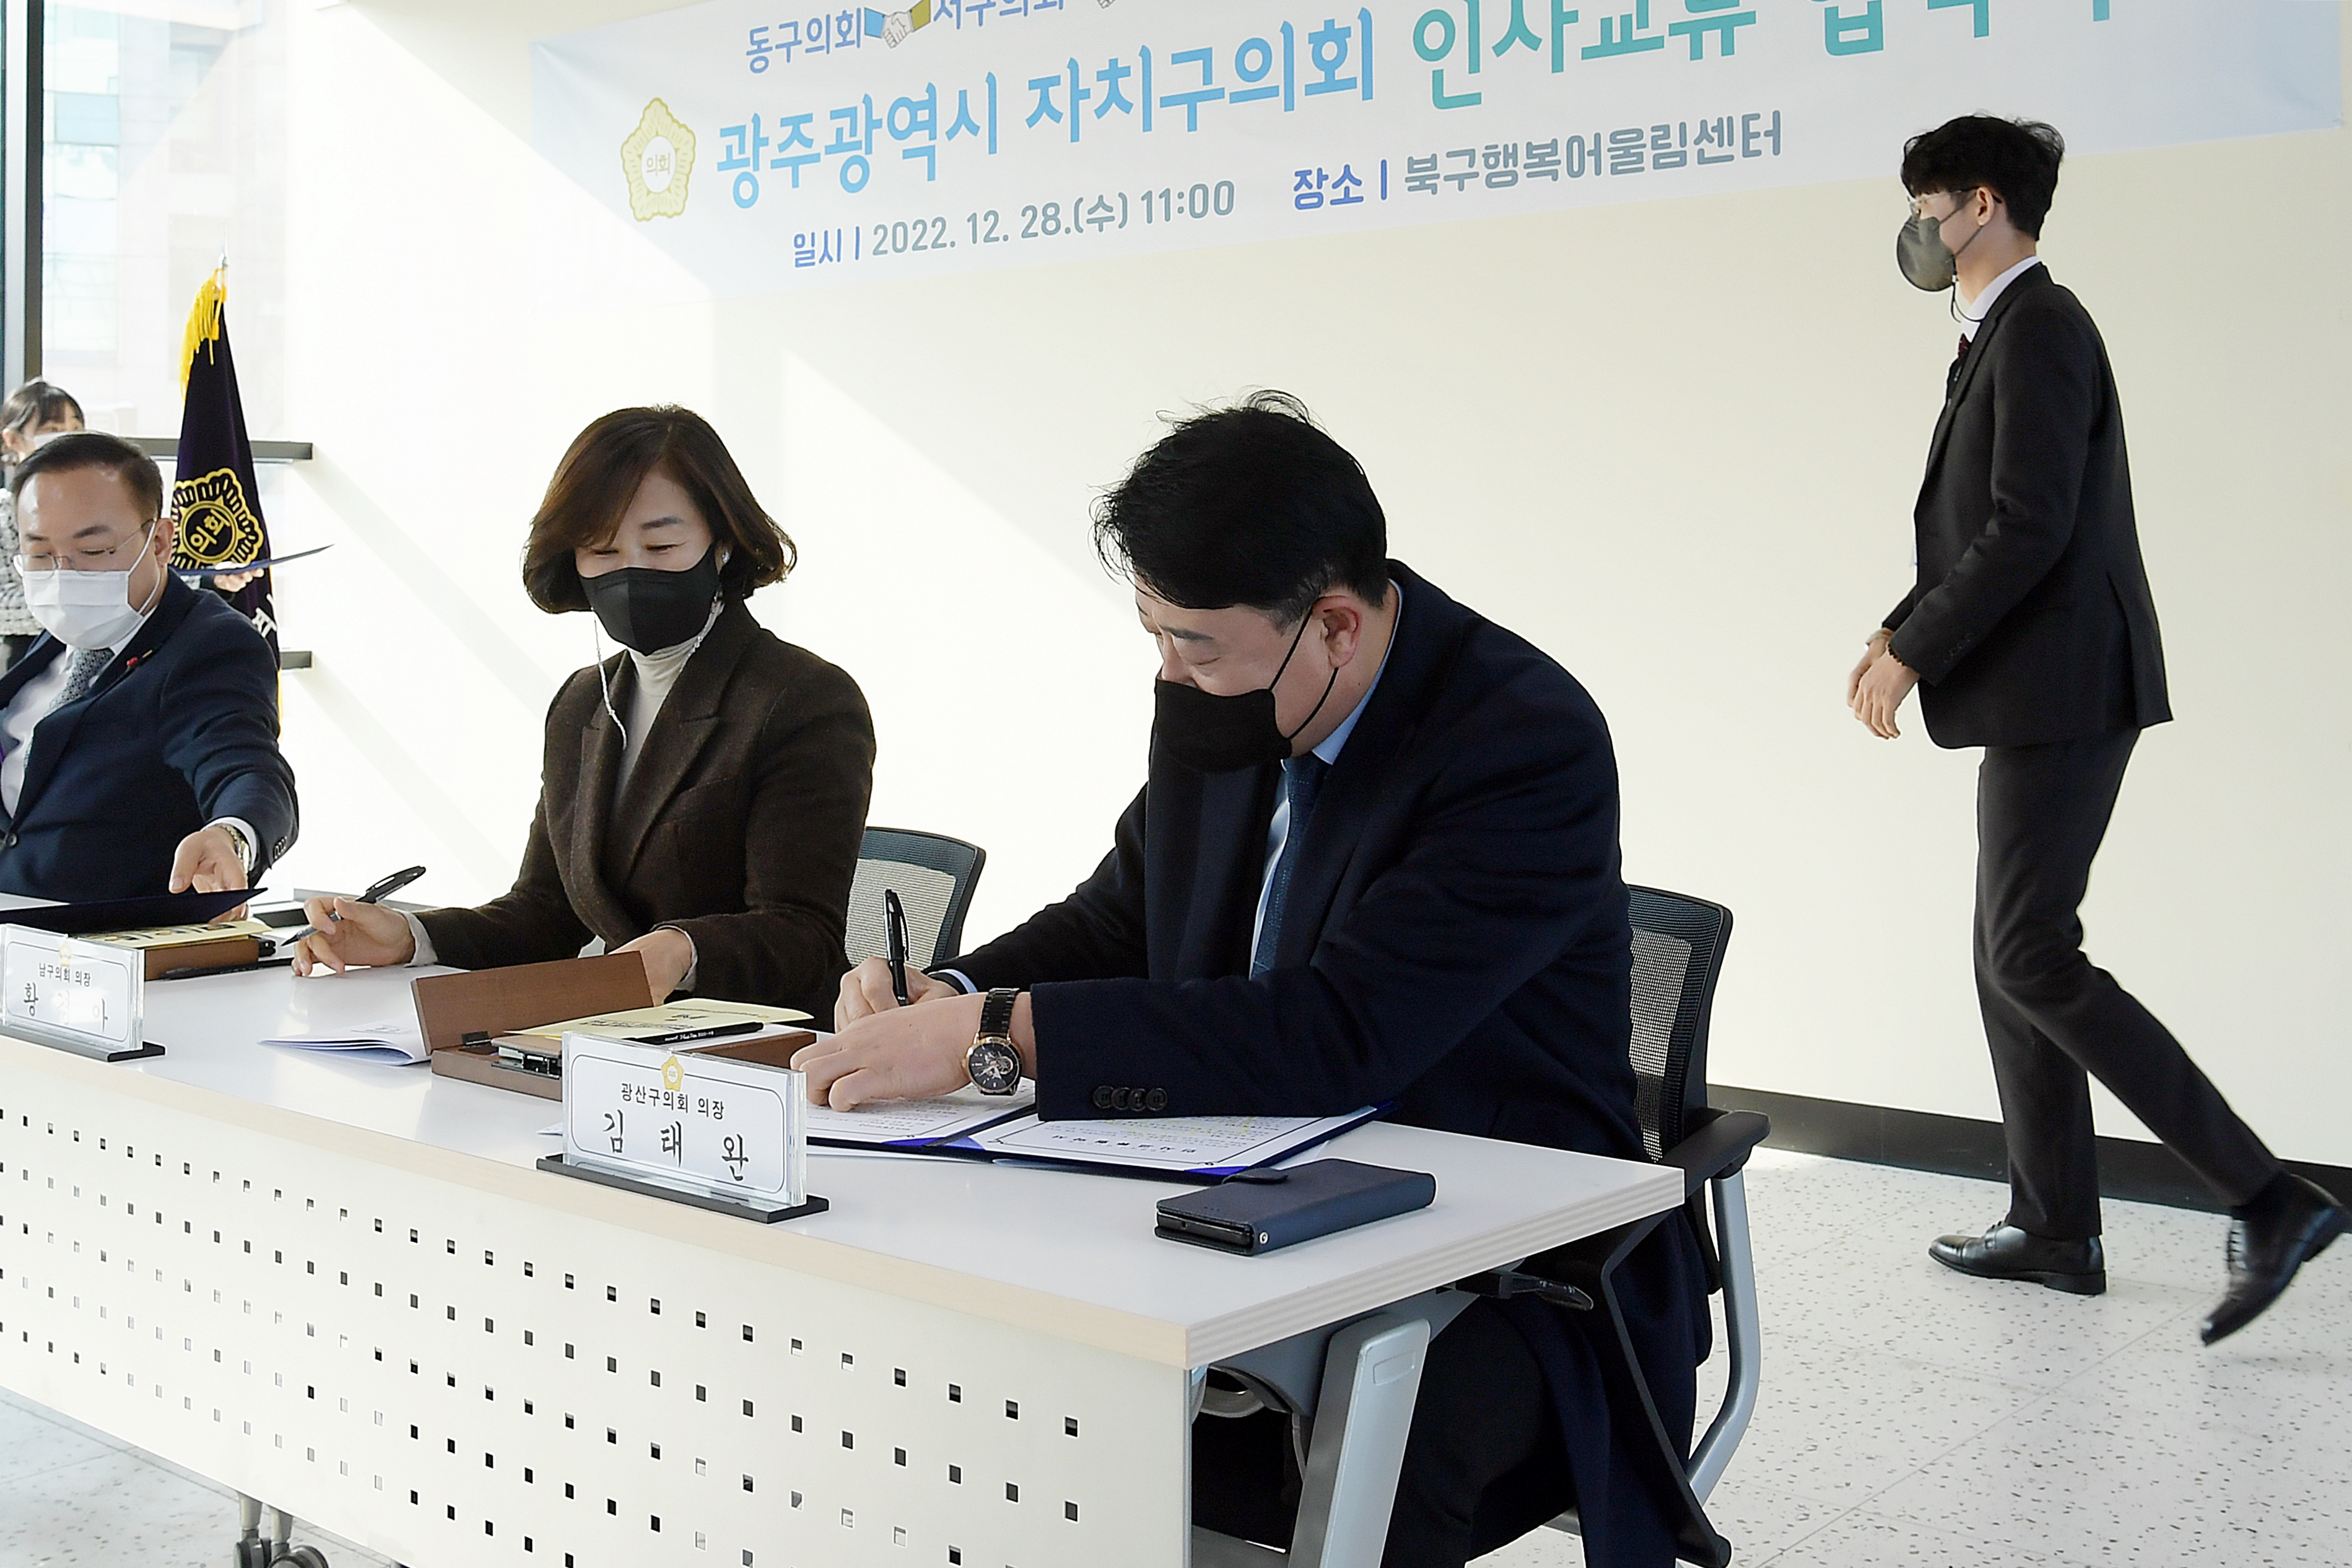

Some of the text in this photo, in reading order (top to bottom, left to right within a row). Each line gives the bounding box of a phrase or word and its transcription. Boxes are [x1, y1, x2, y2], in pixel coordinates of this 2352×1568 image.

[746, 7, 861, 74] 동구의회
[716, 71, 998, 209] 광주광역시
[1027, 7, 1374, 143] 자치구의회
[646, 152, 671, 176] 의회
[1293, 163, 1364, 210] 장소
[1405, 110, 1782, 195] 북구행복어울림센터
[793, 228, 842, 268] 일시
[872, 216, 956, 256] 2022.
[967, 209, 1009, 245] 12.
[1021, 191, 1128, 238] 28.(수)
[1141, 180, 1235, 224] 11:00
[189, 508, 232, 553] 의회
[39, 962, 91, 987] 남구의회 의장
[621, 1082, 725, 1120] 광산구의회 의장
